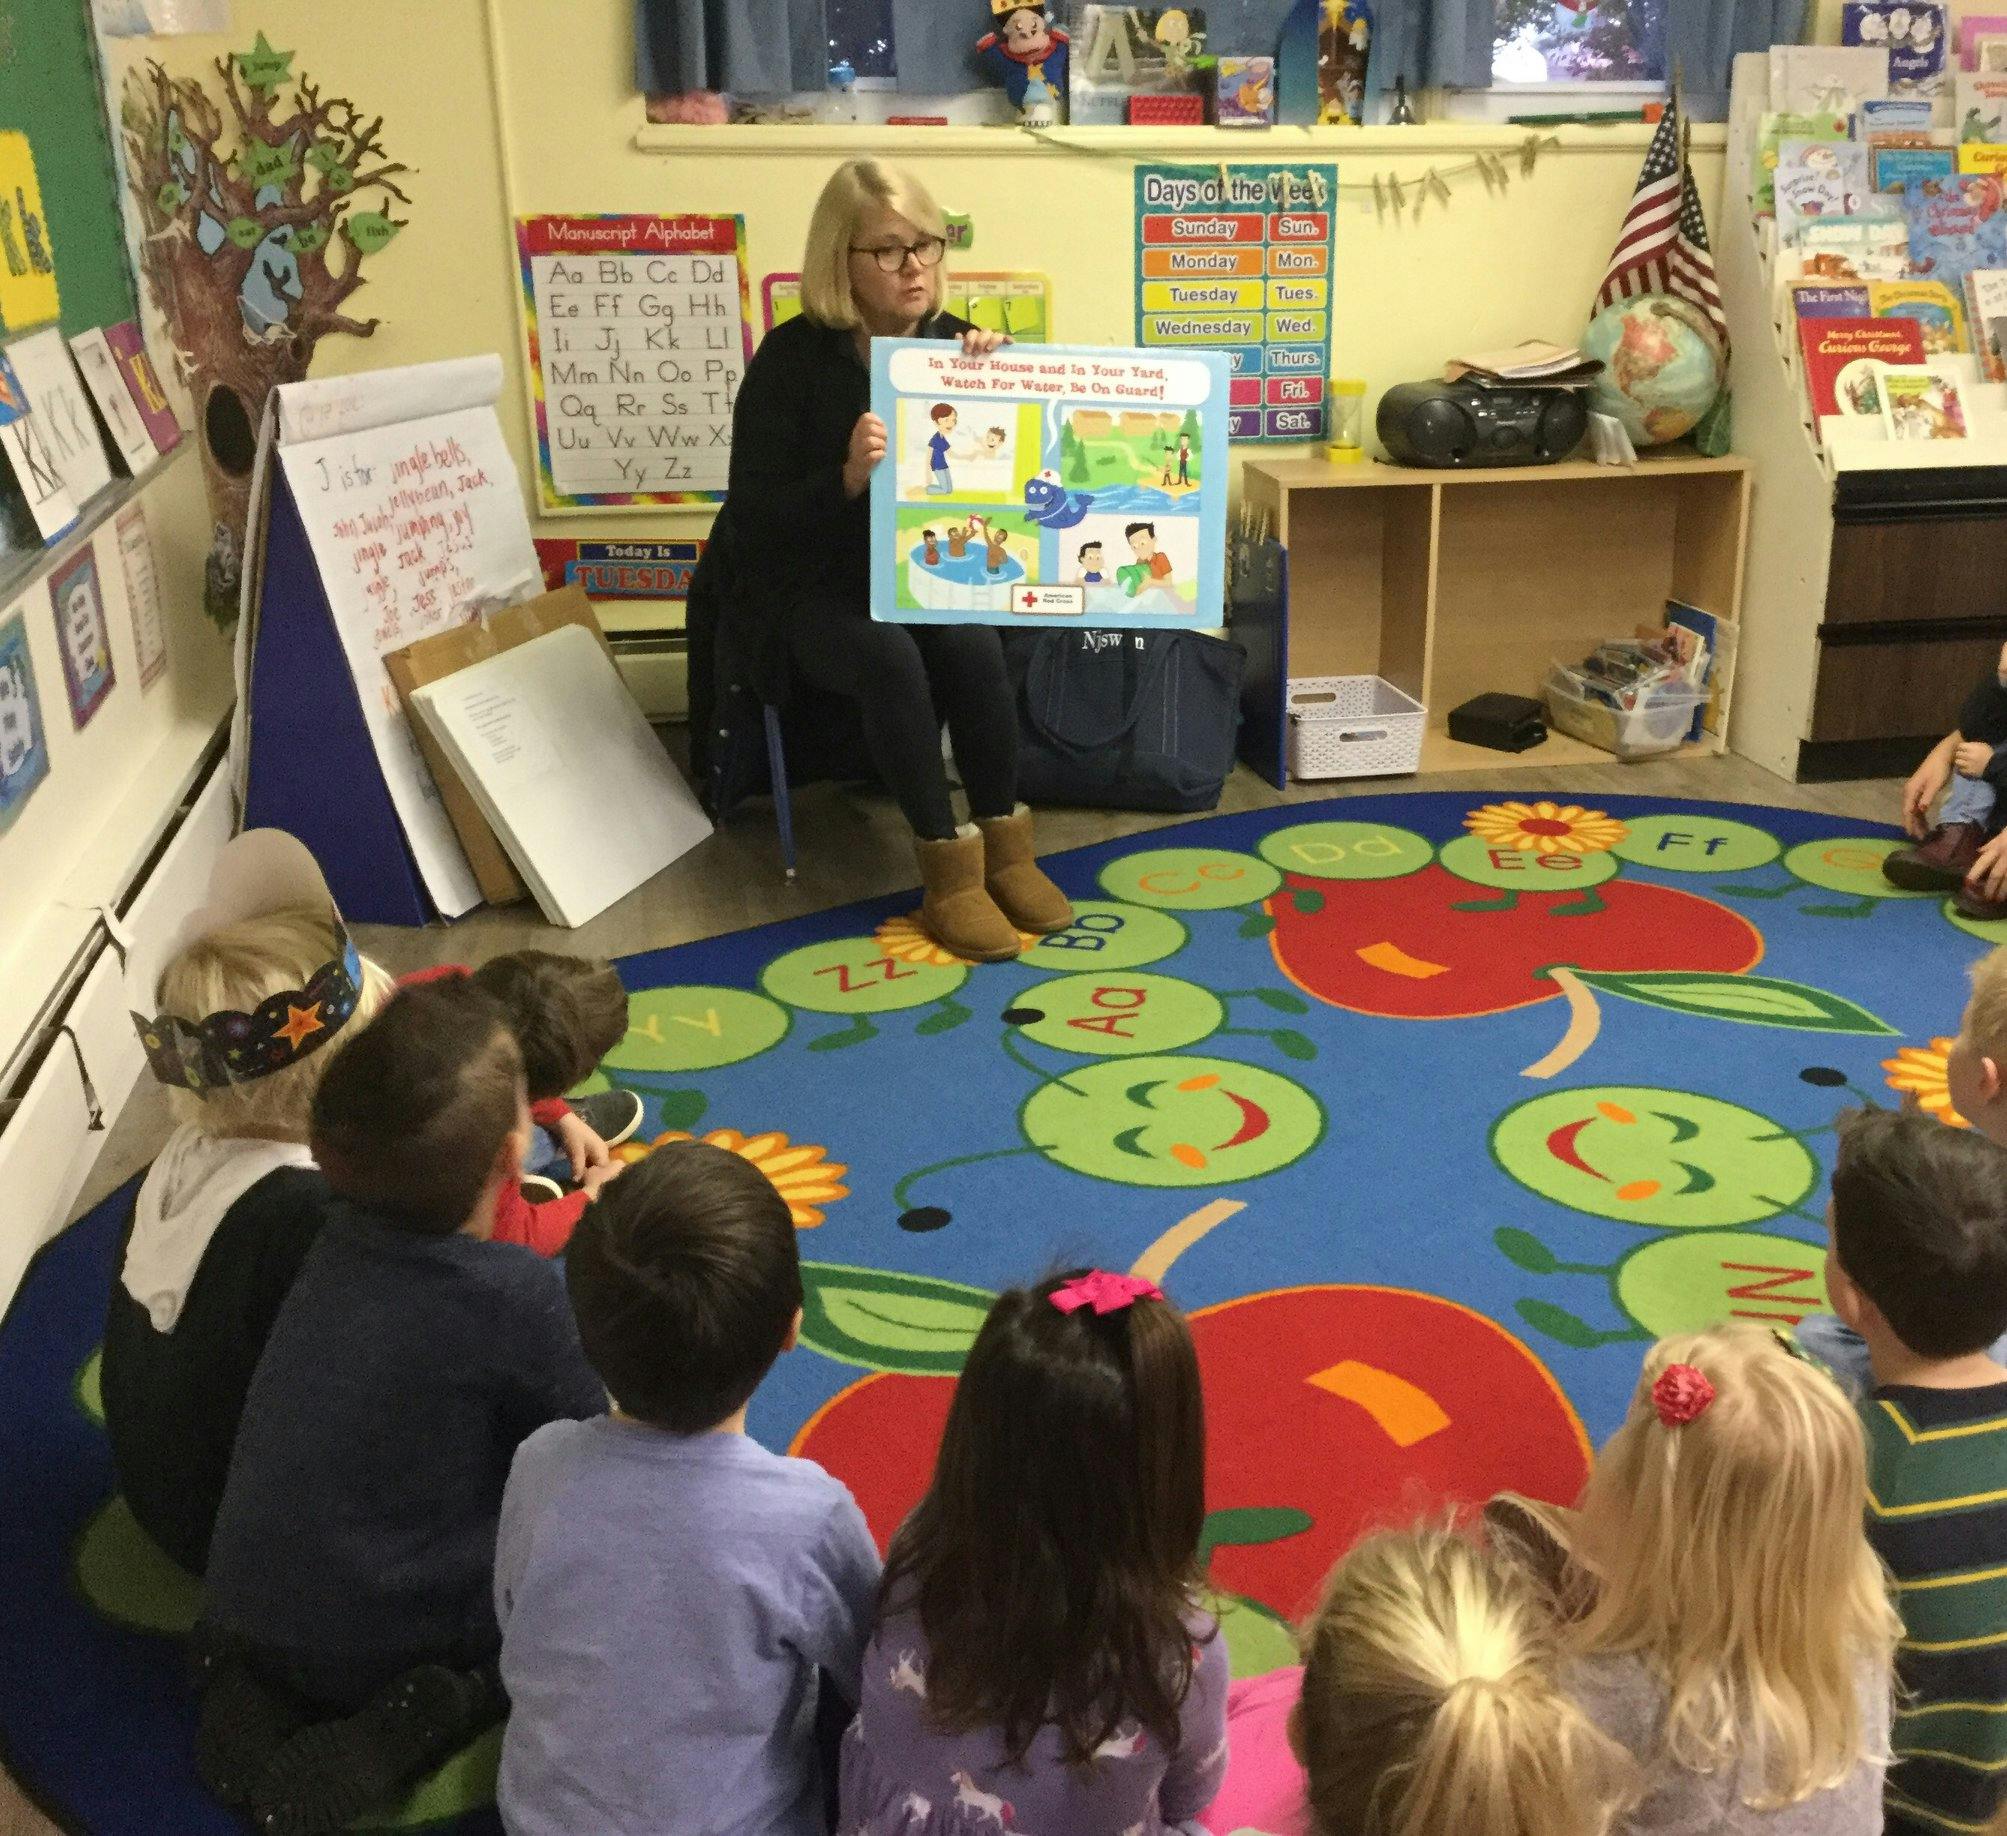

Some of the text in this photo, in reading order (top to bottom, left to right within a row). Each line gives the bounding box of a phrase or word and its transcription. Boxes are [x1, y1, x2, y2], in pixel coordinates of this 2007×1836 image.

[256, 155, 284, 175] dad
[1147, 177, 1196, 207] Days
[1232, 178, 1263, 201] the
[548, 222, 714, 247] Manuscript Alphabet
[1173, 219, 1319, 238] Sunday Sun.
[549, 260, 724, 284] Aa Bb Cc Dd
[1172, 252, 1319, 272] Monday Mon.
[1170, 286, 1318, 304] Tuesday Tues.
[550, 294, 727, 327] Ee Ff Gg Hh
[1155, 319, 1316, 336] Wednesday Wed.
[553, 327, 730, 361] Ii Jj Kk Ll
[1818, 340, 1912, 355] Curious George
[928, 357, 1169, 382] In Your House and In Your Yard,
[1271, 351, 1320, 366] Thurs.
[551, 360, 737, 394] Mm Nn Oo Pp
[941, 375, 1165, 400] Watch For Water, Be On Guard!
[1281, 383, 1310, 399] Fri.
[560, 392, 734, 427] Qq Rr Ss Tt
[1279, 413, 1311, 429] Sat.
[557, 427, 591, 449] Uu
[607, 426, 636, 448] Vv
[648, 425, 700, 447] Ww
[315, 457, 330, 491] J
[339, 465, 354, 491] is
[614, 457, 692, 489] Yy Zz
[606, 544, 671, 559] Today Is
[575, 566, 695, 590] TUESDA
[1290, 836, 1402, 864] Dd
[1656, 832, 1728, 857] Ff
[1488, 849, 1584, 872] Ee
[1139, 863, 1246, 896] Cc
[1038, 913, 1126, 952] Bb
[812, 956, 919, 993] Zz
[1066, 986, 1148, 1039] Aa
